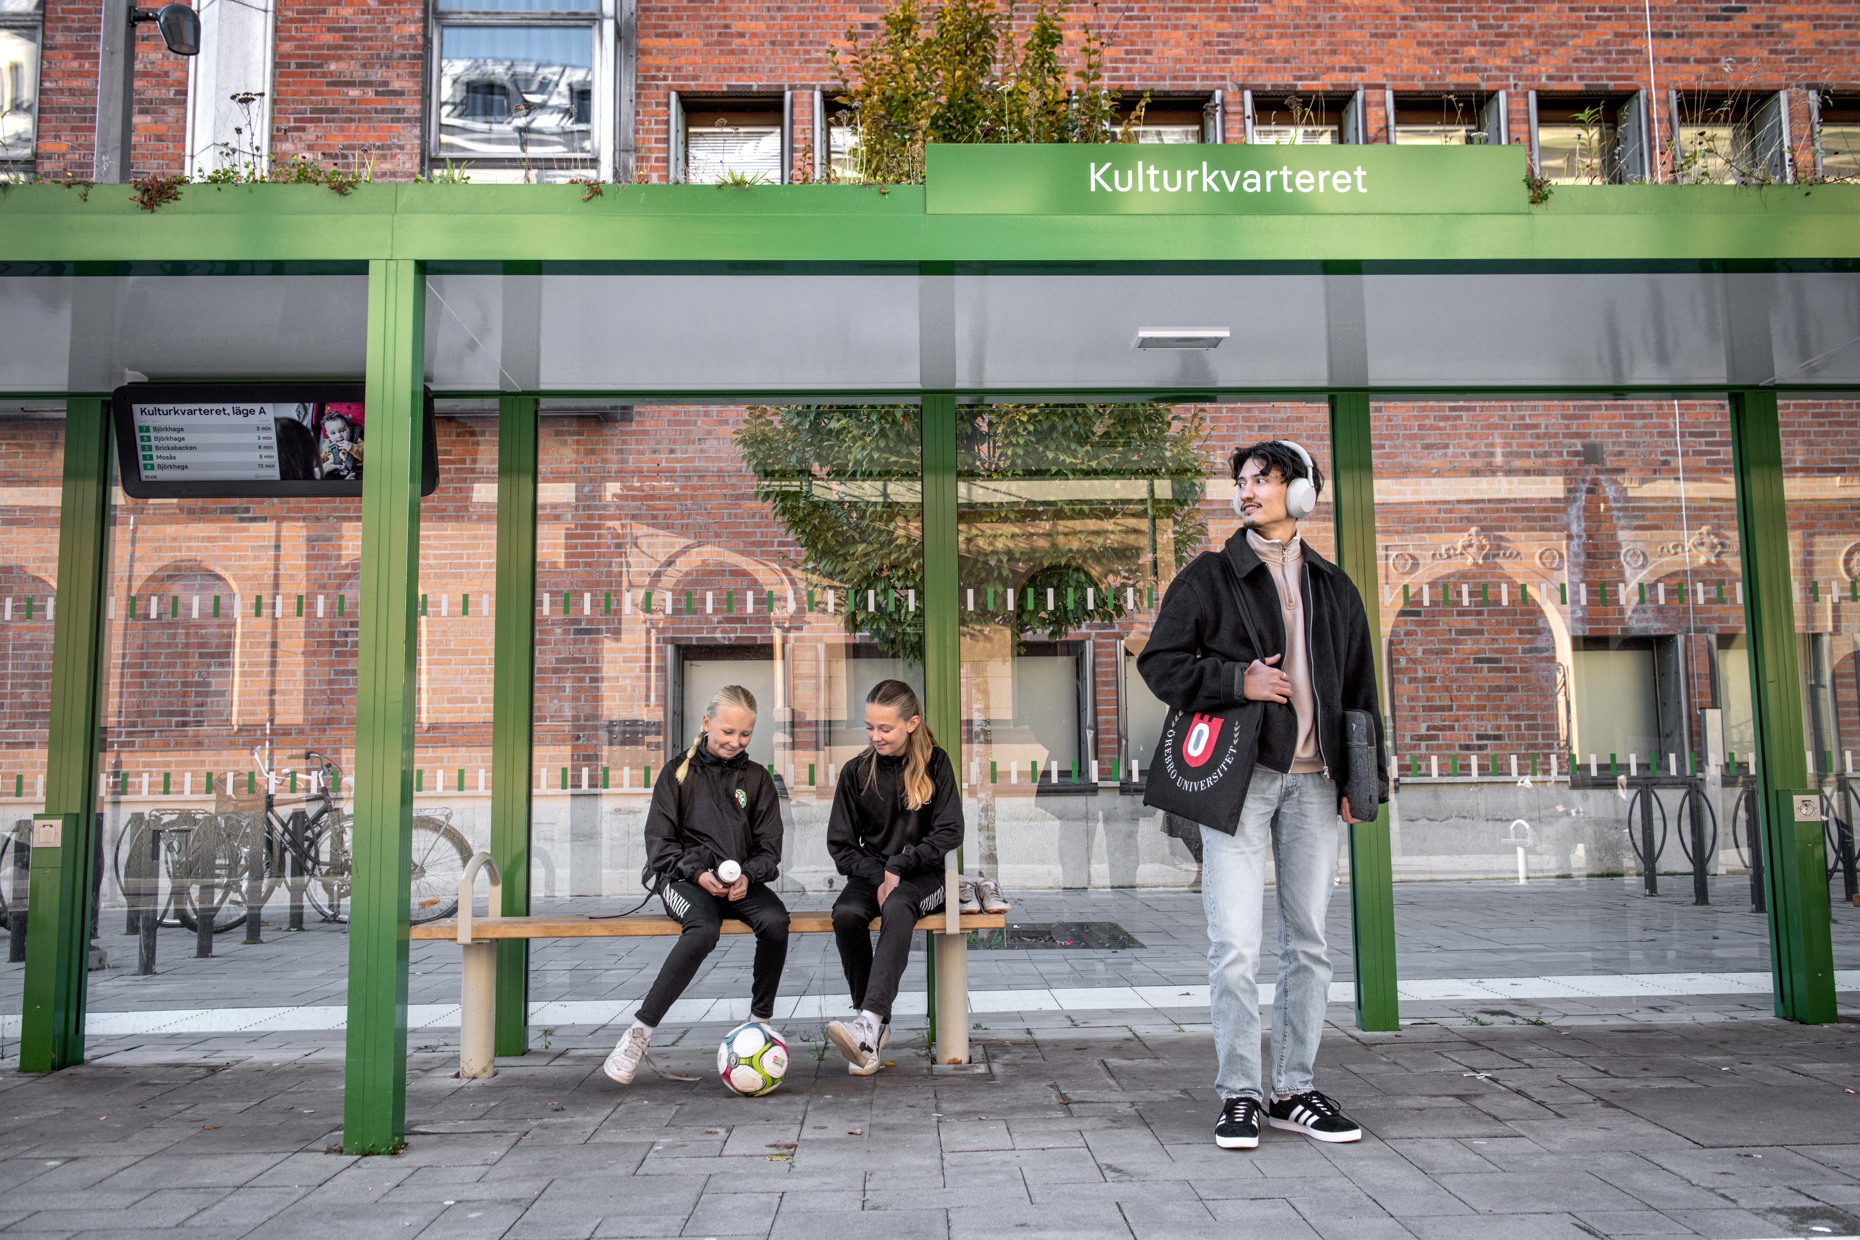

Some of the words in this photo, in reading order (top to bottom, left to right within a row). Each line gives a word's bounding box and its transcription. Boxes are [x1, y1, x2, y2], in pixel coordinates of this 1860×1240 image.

[1089, 160, 1368, 193] Kulturkvarteret
[140, 406, 231, 416] Kulturkvarteret,
[232, 406, 255, 418] läge
[258, 407, 267, 416] A
[157, 463, 189, 471] Björkhaga
[1164, 729, 1177, 779] ÖREBRO
[1176, 745, 1237, 792] UNIVERSITET
